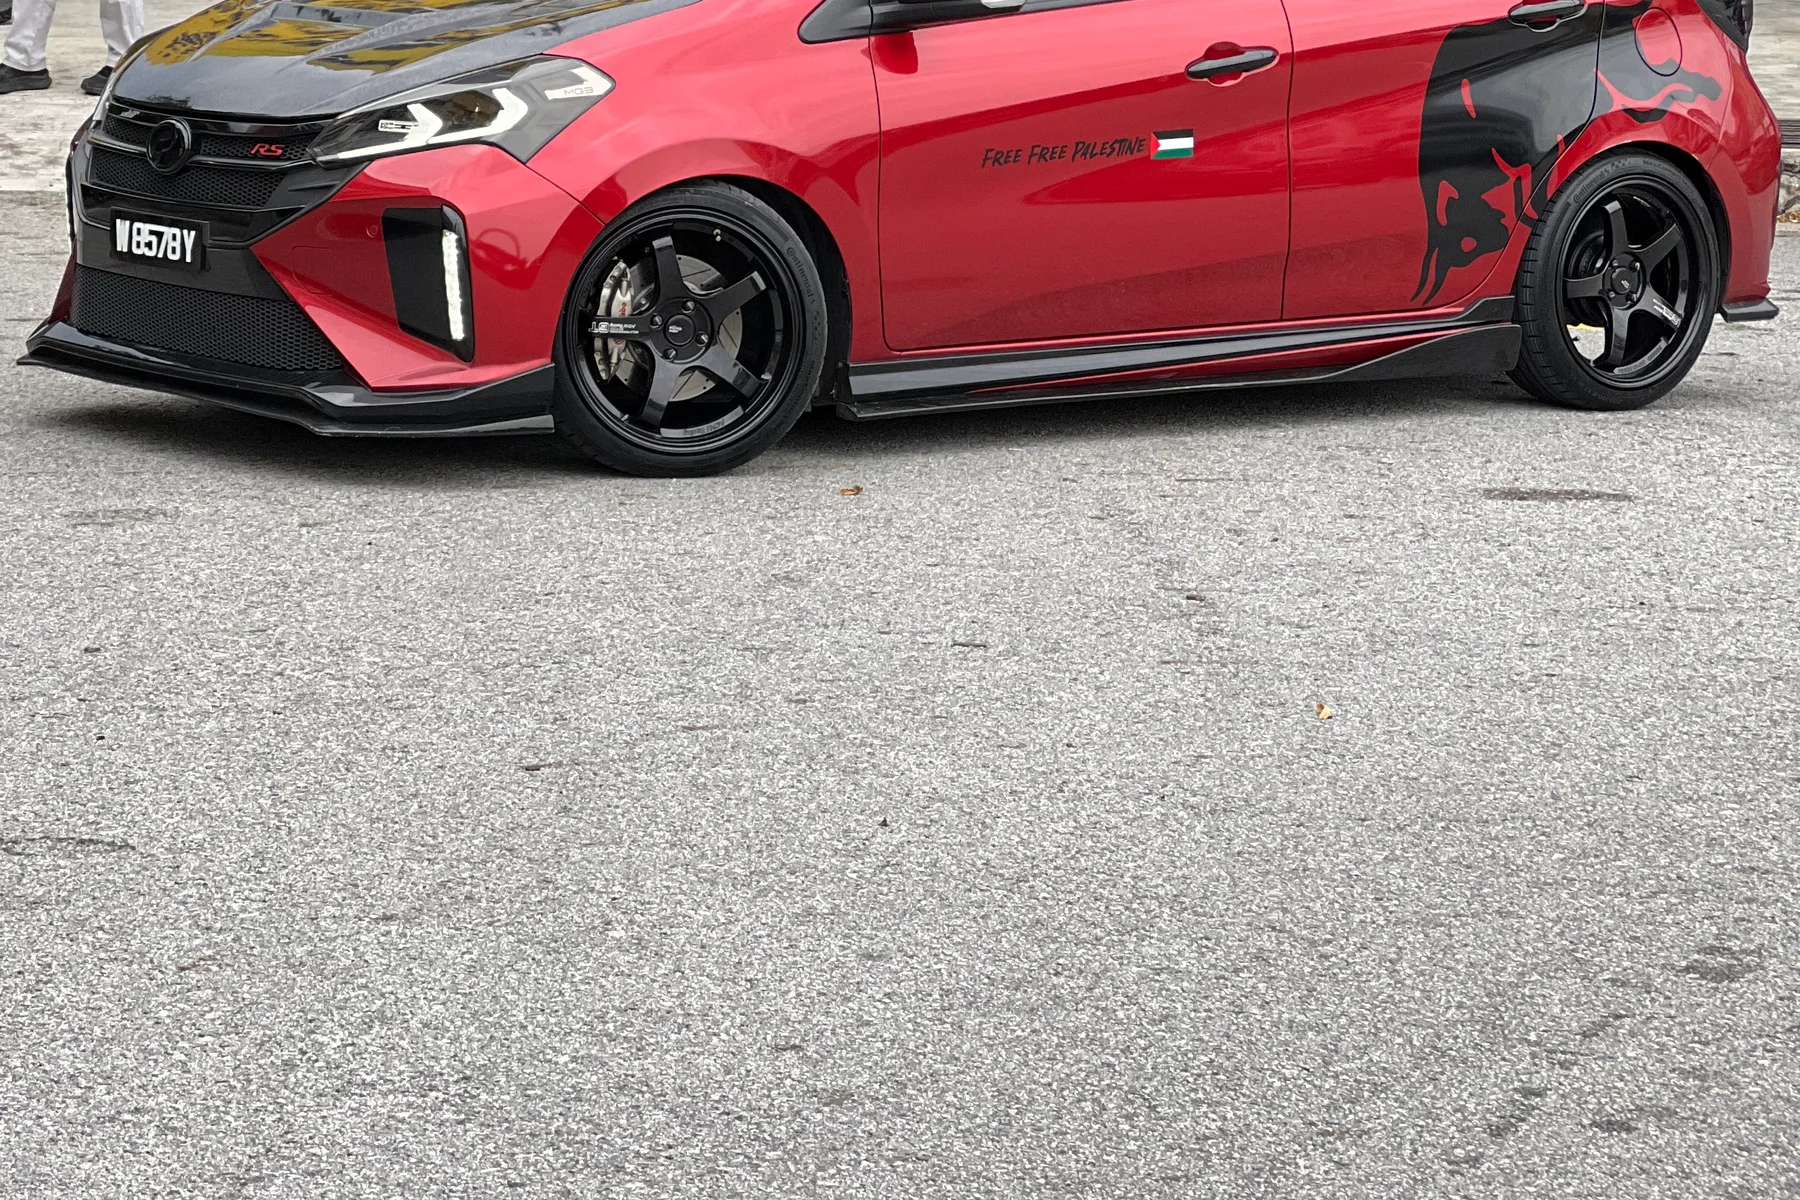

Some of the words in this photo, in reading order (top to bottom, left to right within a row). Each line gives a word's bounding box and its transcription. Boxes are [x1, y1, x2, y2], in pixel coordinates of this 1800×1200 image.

[250, 143, 285, 156] RS
[981, 148, 1023, 169] FREE
[1027, 144, 1068, 166] FREE
[1071, 136, 1147, 162] PALESTINE
